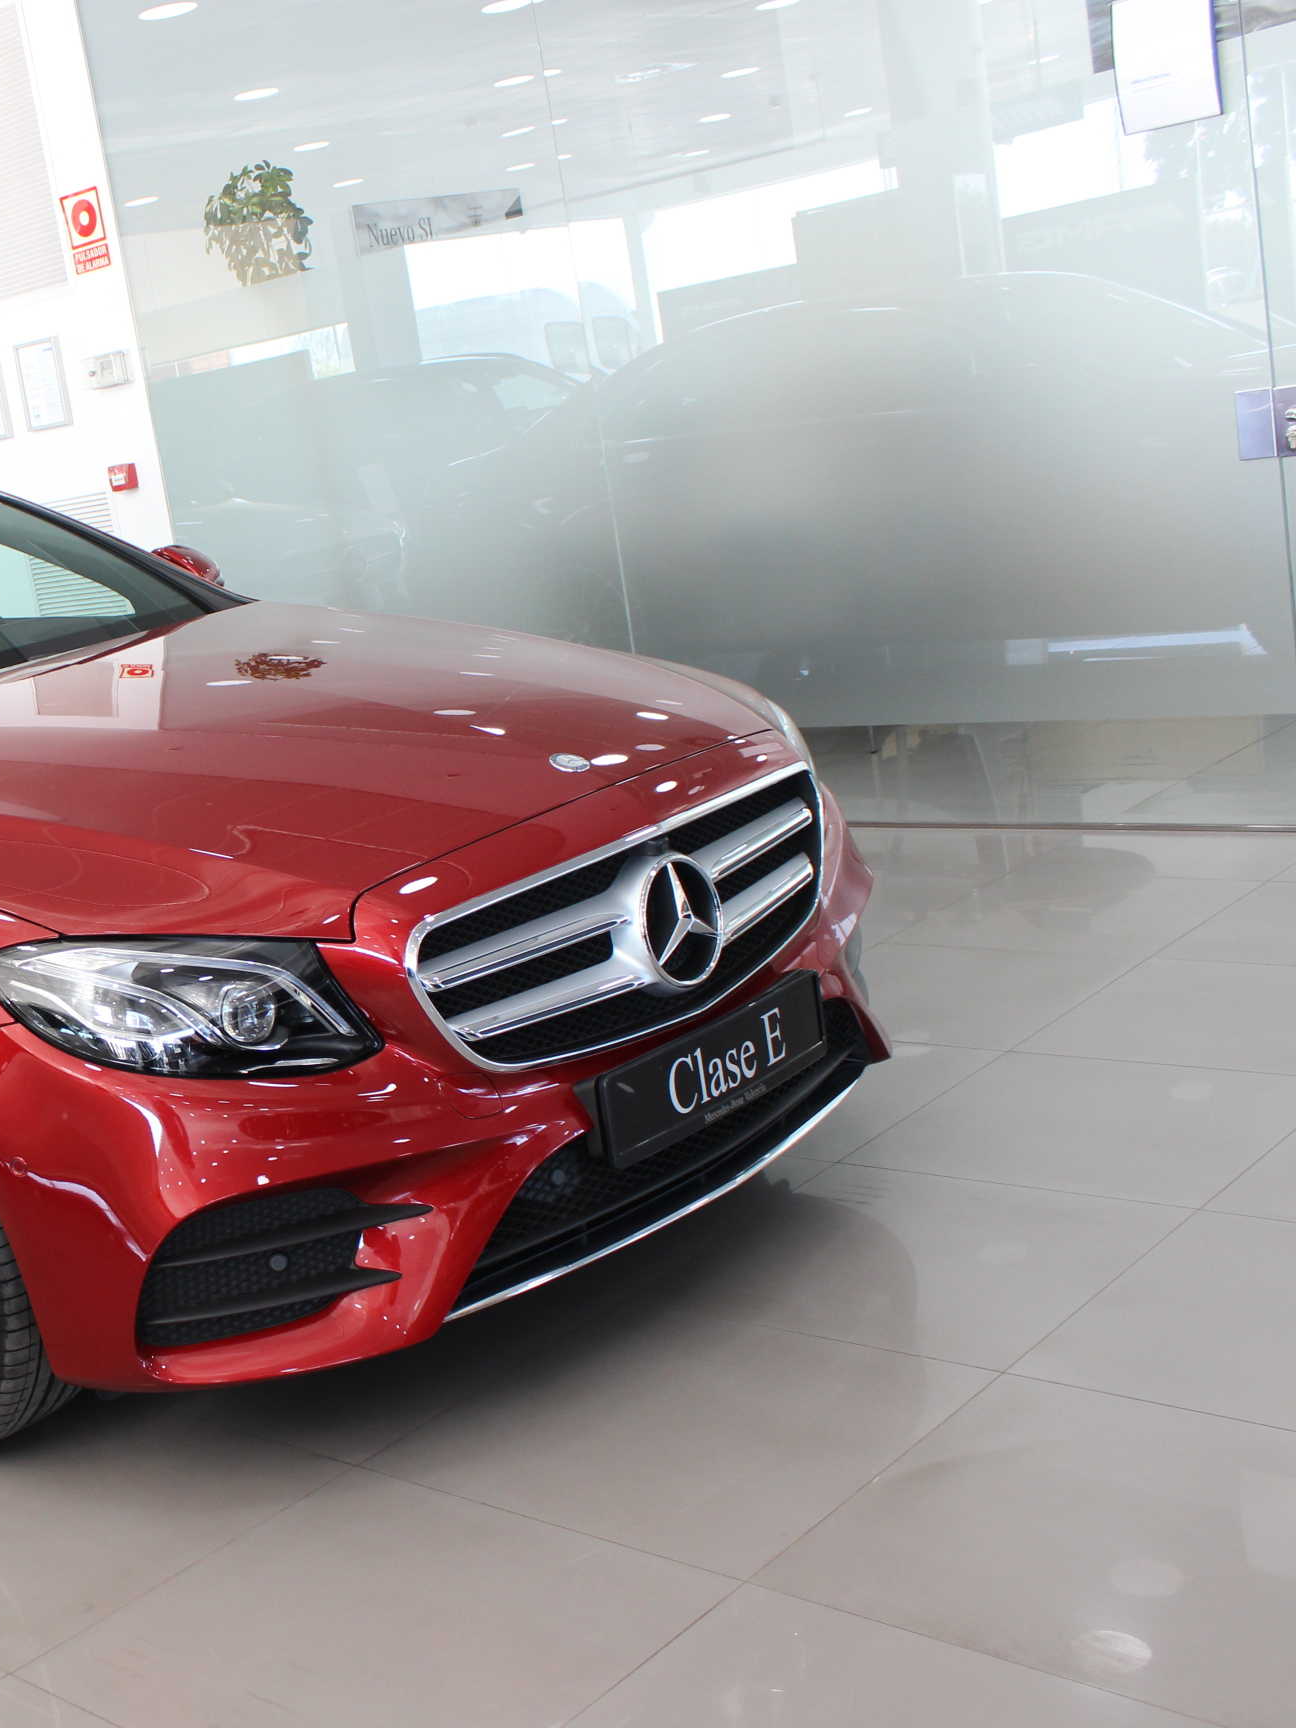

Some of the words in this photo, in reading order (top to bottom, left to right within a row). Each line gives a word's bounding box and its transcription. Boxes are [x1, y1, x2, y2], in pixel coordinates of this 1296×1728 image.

[367, 224, 415, 247] Nuevo
[75, 246, 108, 264] PULSADOR
[85, 255, 110, 270] ALARMA
[669, 1041, 756, 1114] Clase
[760, 1008, 786, 1066] E
